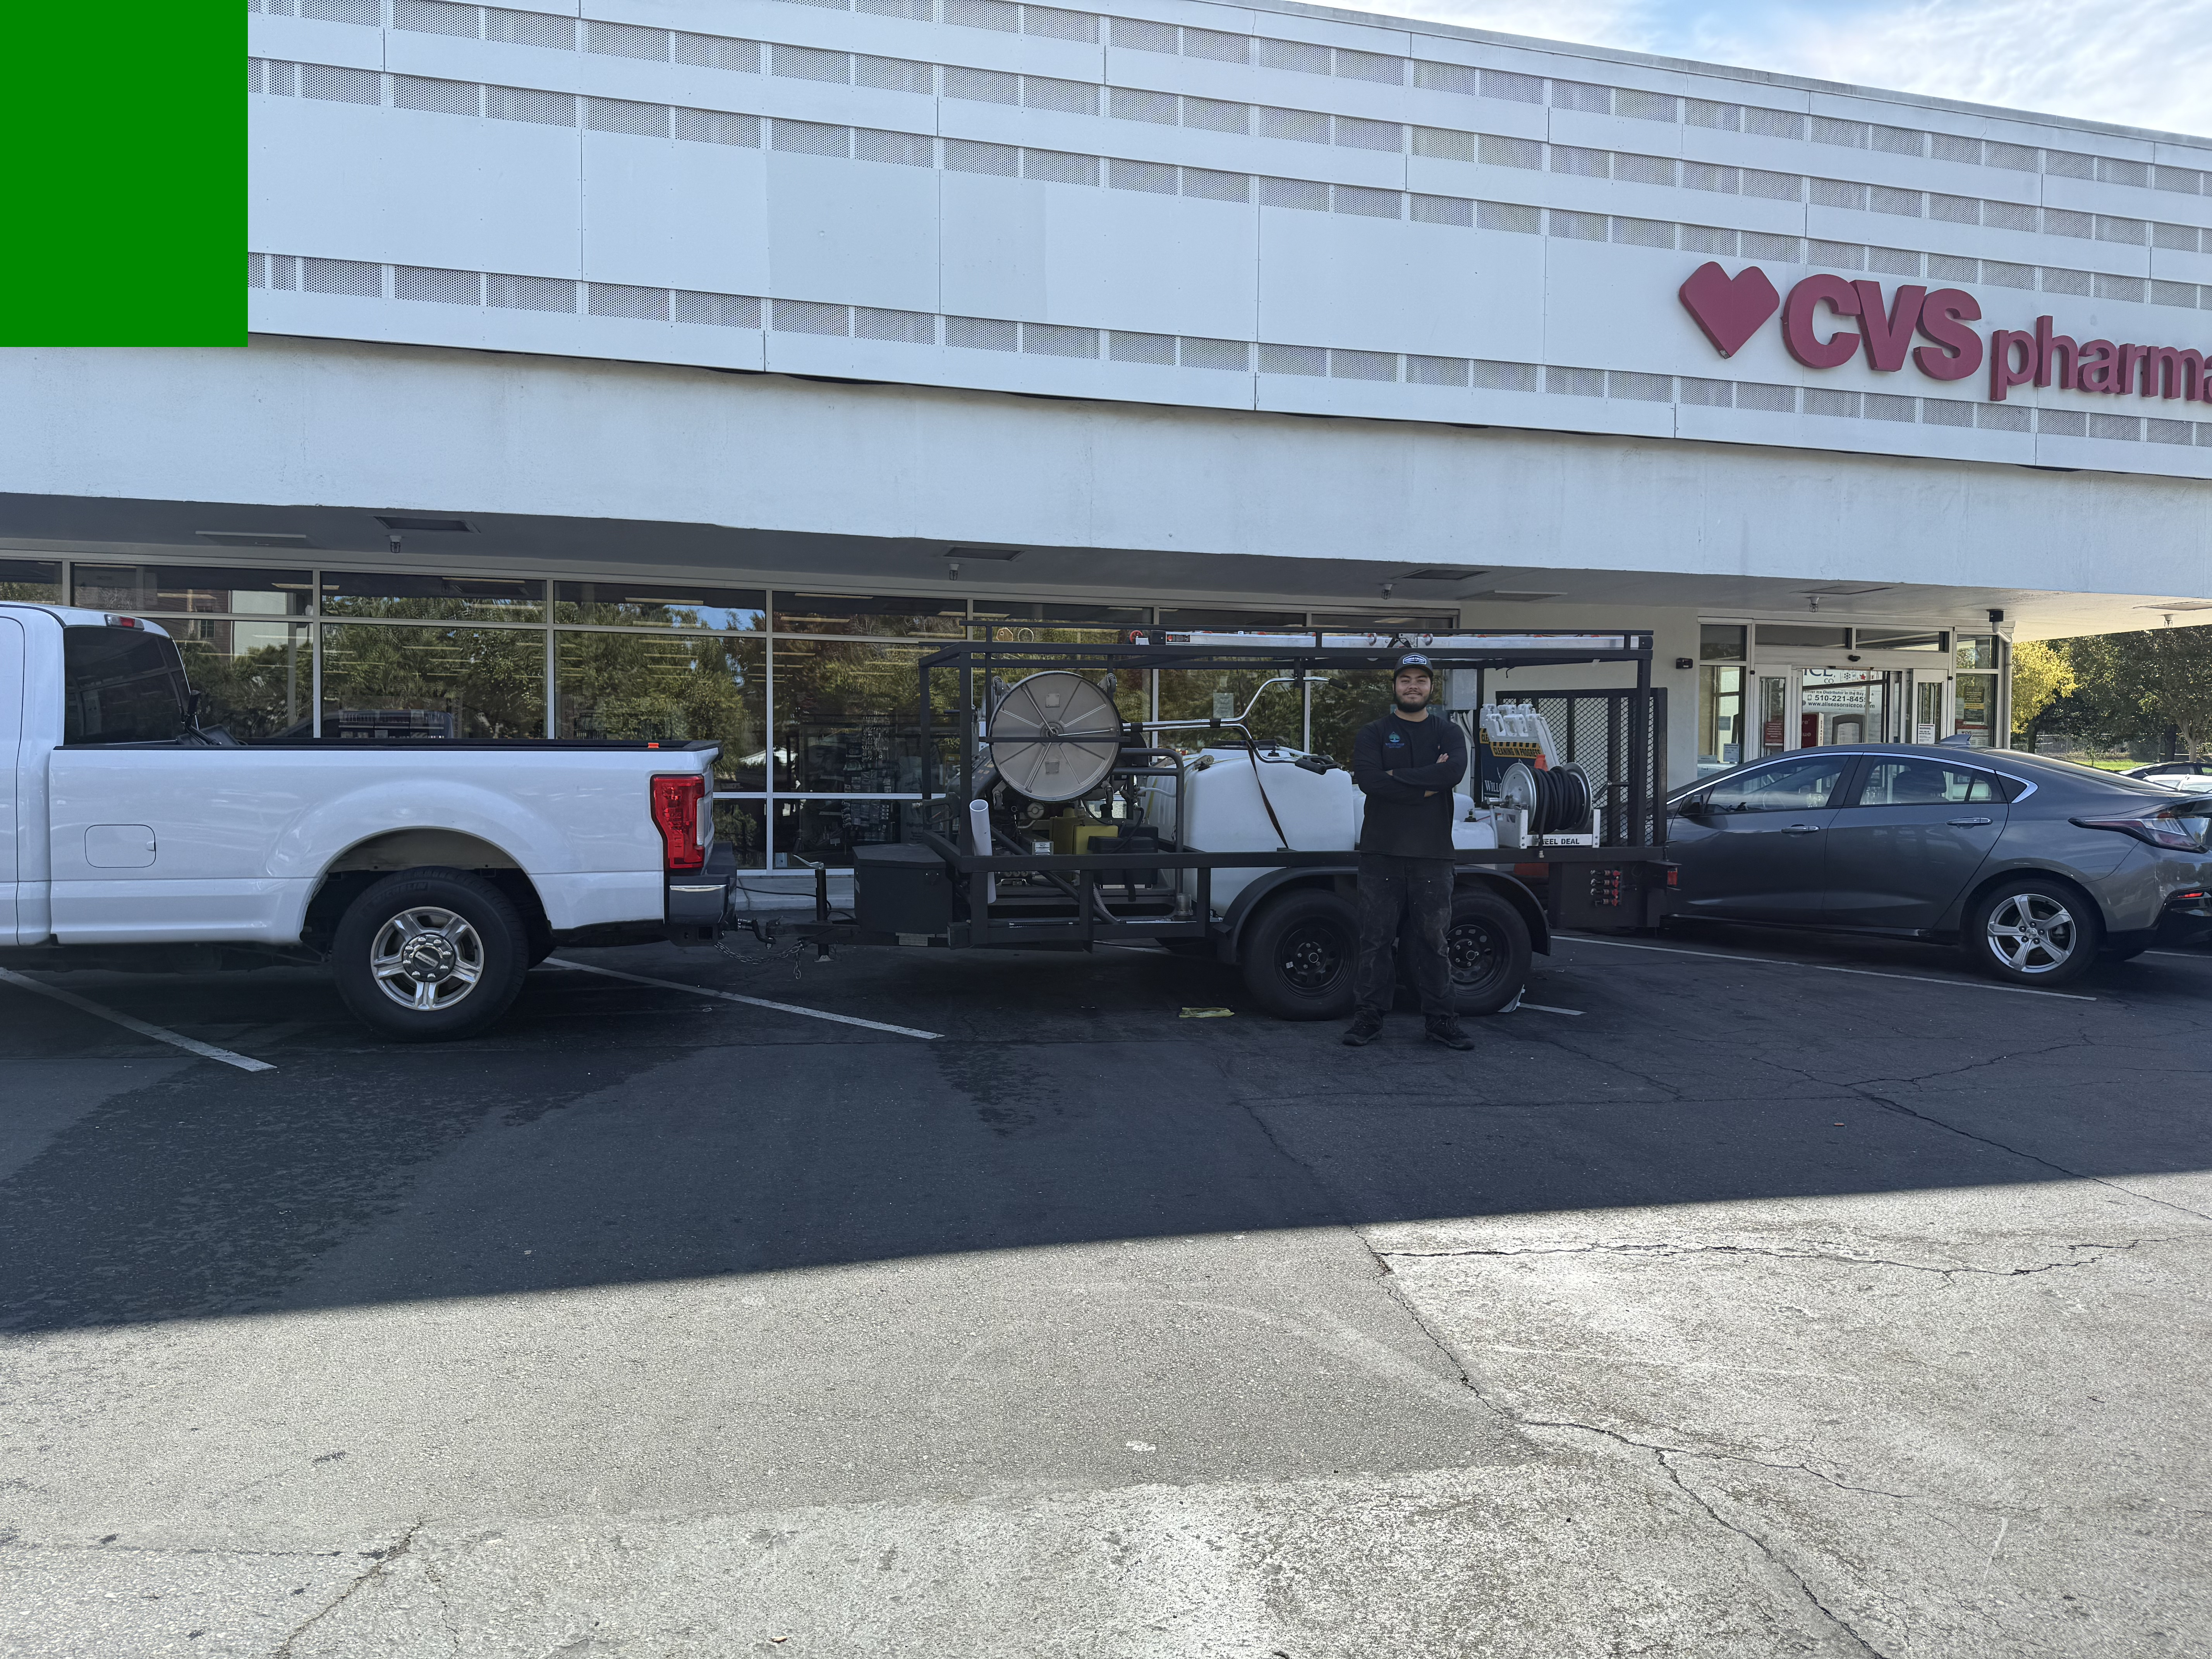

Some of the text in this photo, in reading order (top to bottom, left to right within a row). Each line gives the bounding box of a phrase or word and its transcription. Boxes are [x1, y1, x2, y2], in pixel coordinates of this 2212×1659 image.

[1782, 273, 2212, 404] CVS pharm
[1493, 747, 1515, 756] CLEANING
[418, 955, 435, 965] FORD
